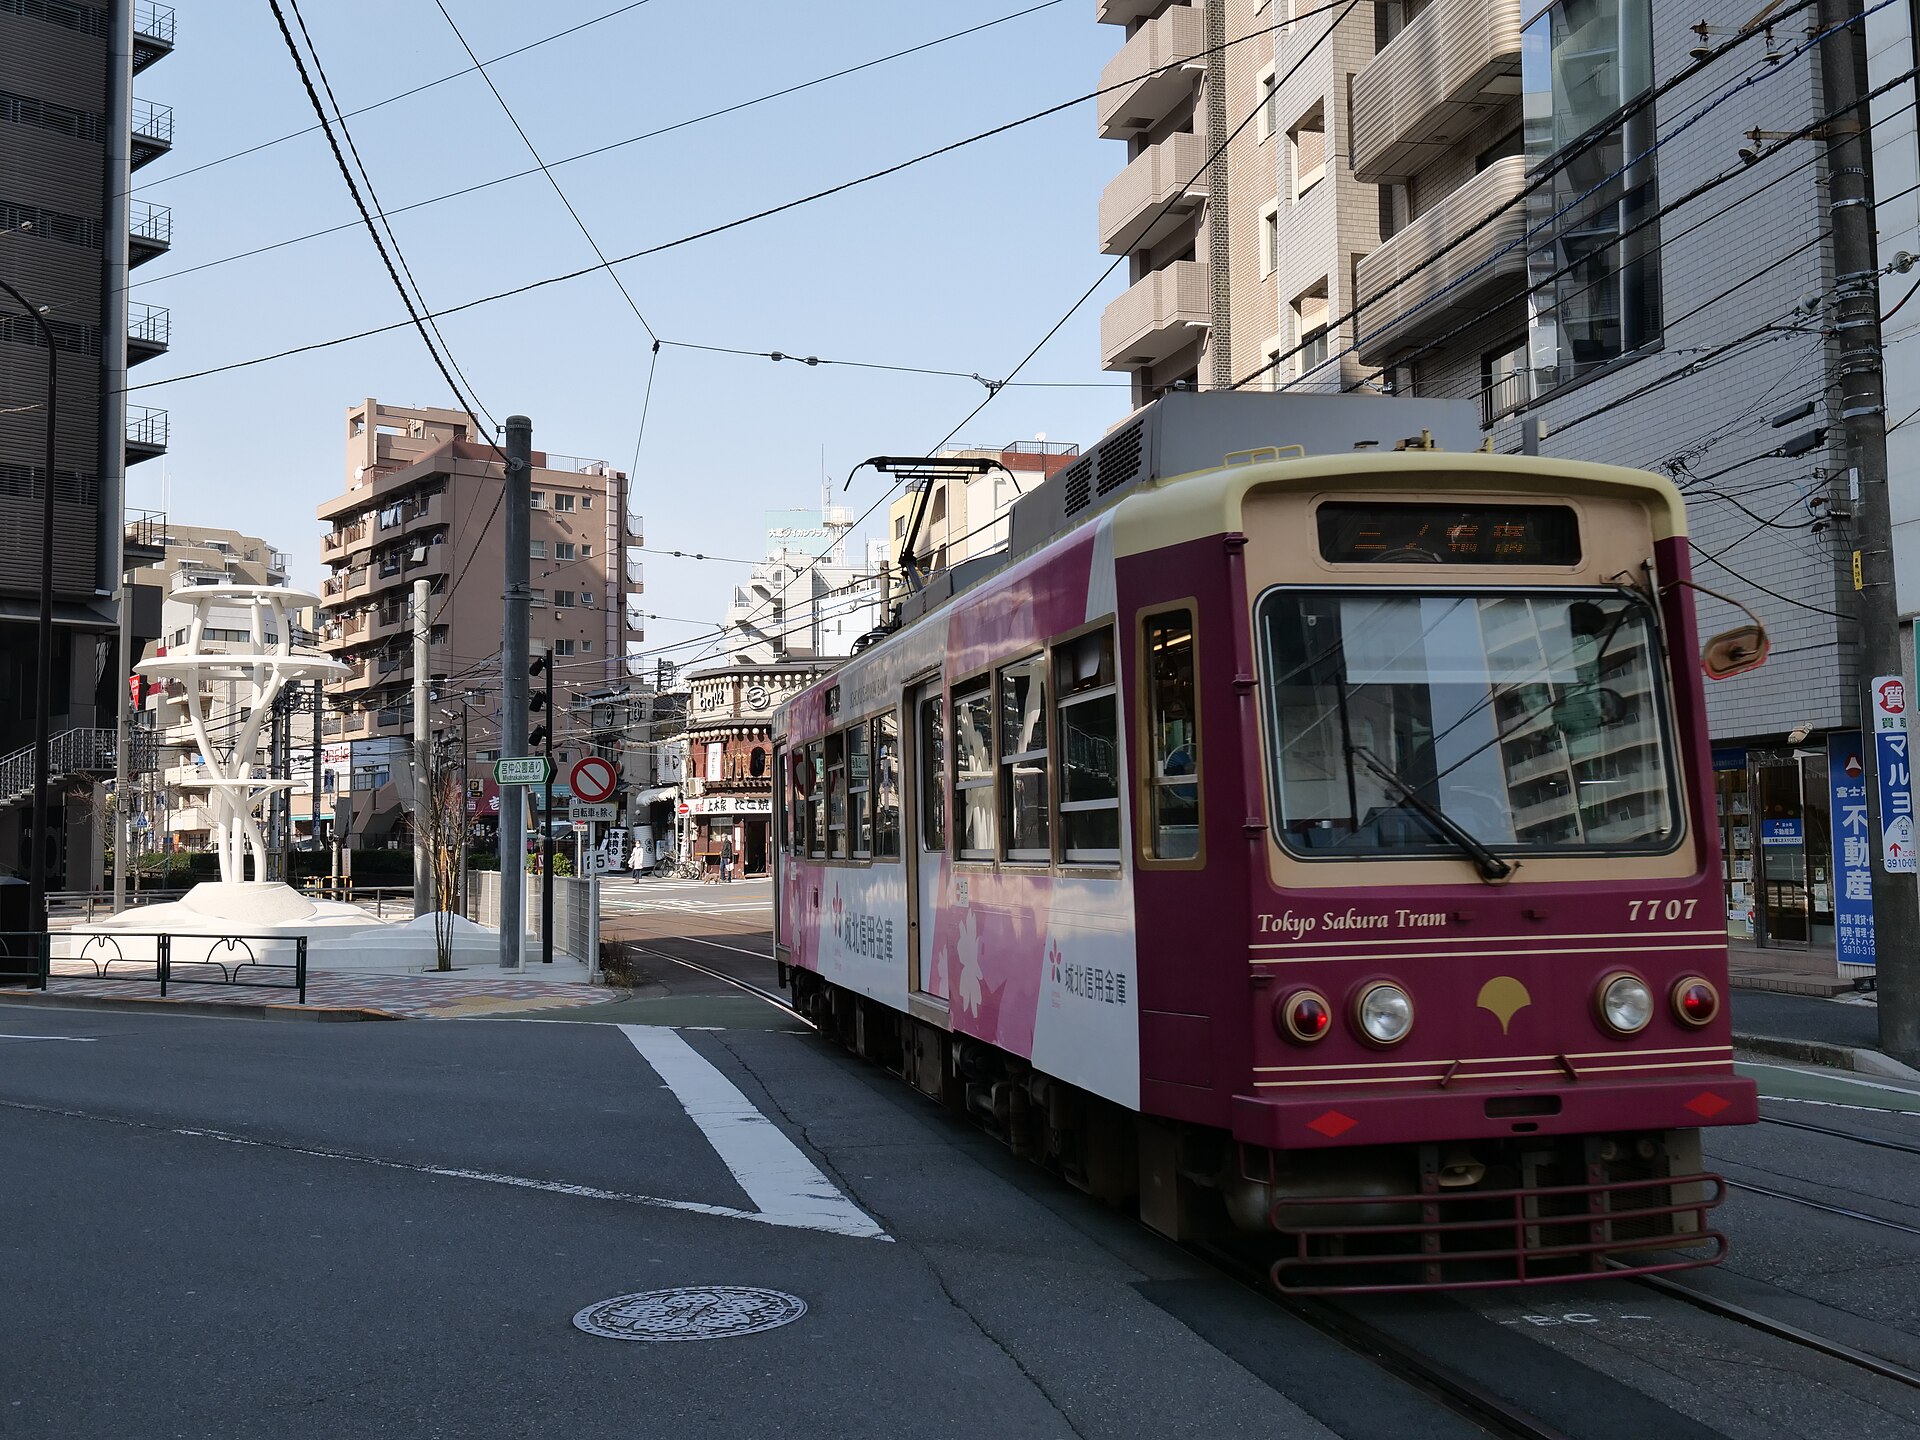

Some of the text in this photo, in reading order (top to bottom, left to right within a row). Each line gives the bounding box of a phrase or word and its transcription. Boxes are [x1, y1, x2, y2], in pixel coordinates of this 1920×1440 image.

[1884, 686, 1904, 709] 質
[501, 760, 542, 775] 宮仲公園通り
[1885, 735, 1911, 814] マルヨ
[572, 807, 613, 818] 自転車を除く
[1842, 804, 1872, 900] 不動産
[1257, 907, 1447, 941] Tokyo Sakura Tram
[1628, 898, 1698, 921] 7707
[844, 908, 894, 964] 城北信用金庫
[1065, 963, 1127, 1006] 城北信用金庫
